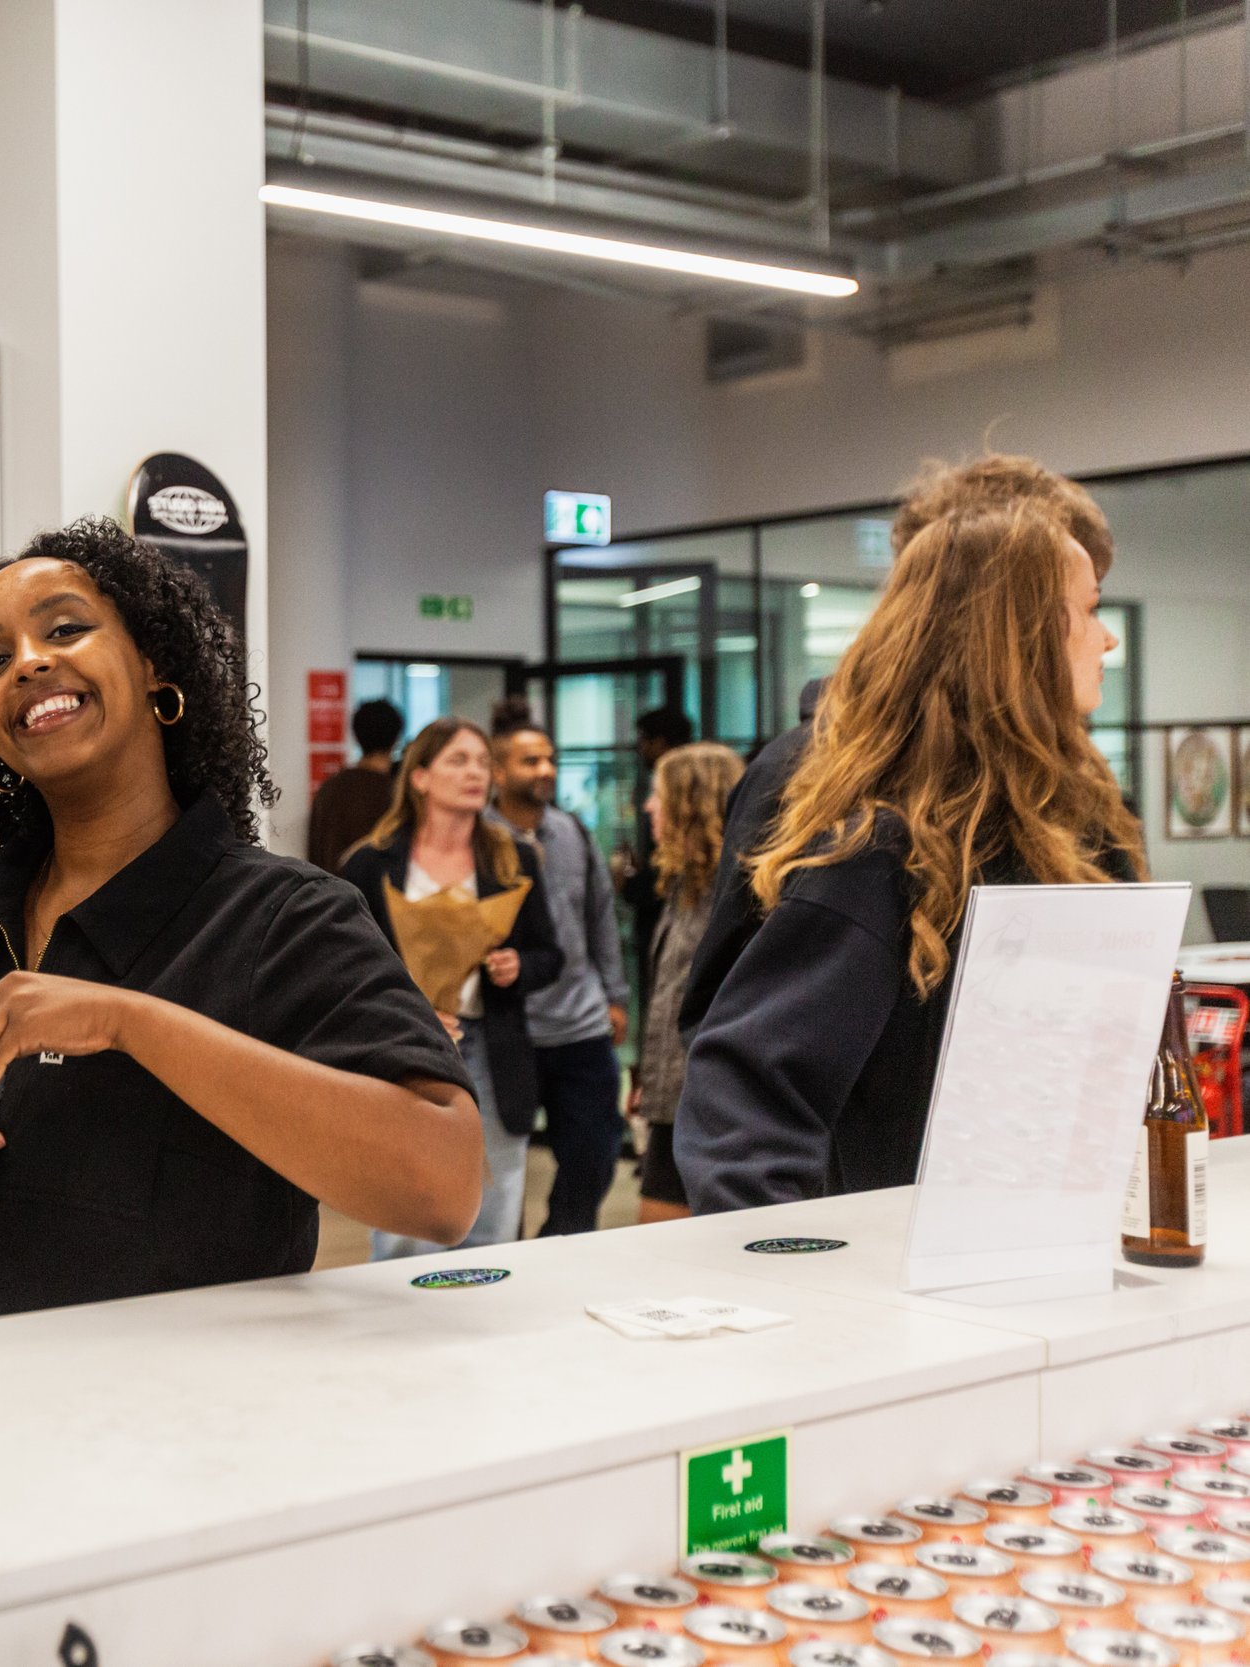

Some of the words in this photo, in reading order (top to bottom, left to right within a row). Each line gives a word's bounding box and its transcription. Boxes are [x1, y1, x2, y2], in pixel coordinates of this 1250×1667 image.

[712, 1501, 741, 1521] First
[744, 1495, 763, 1514] aid
[713, 1534, 747, 1552] nearest
